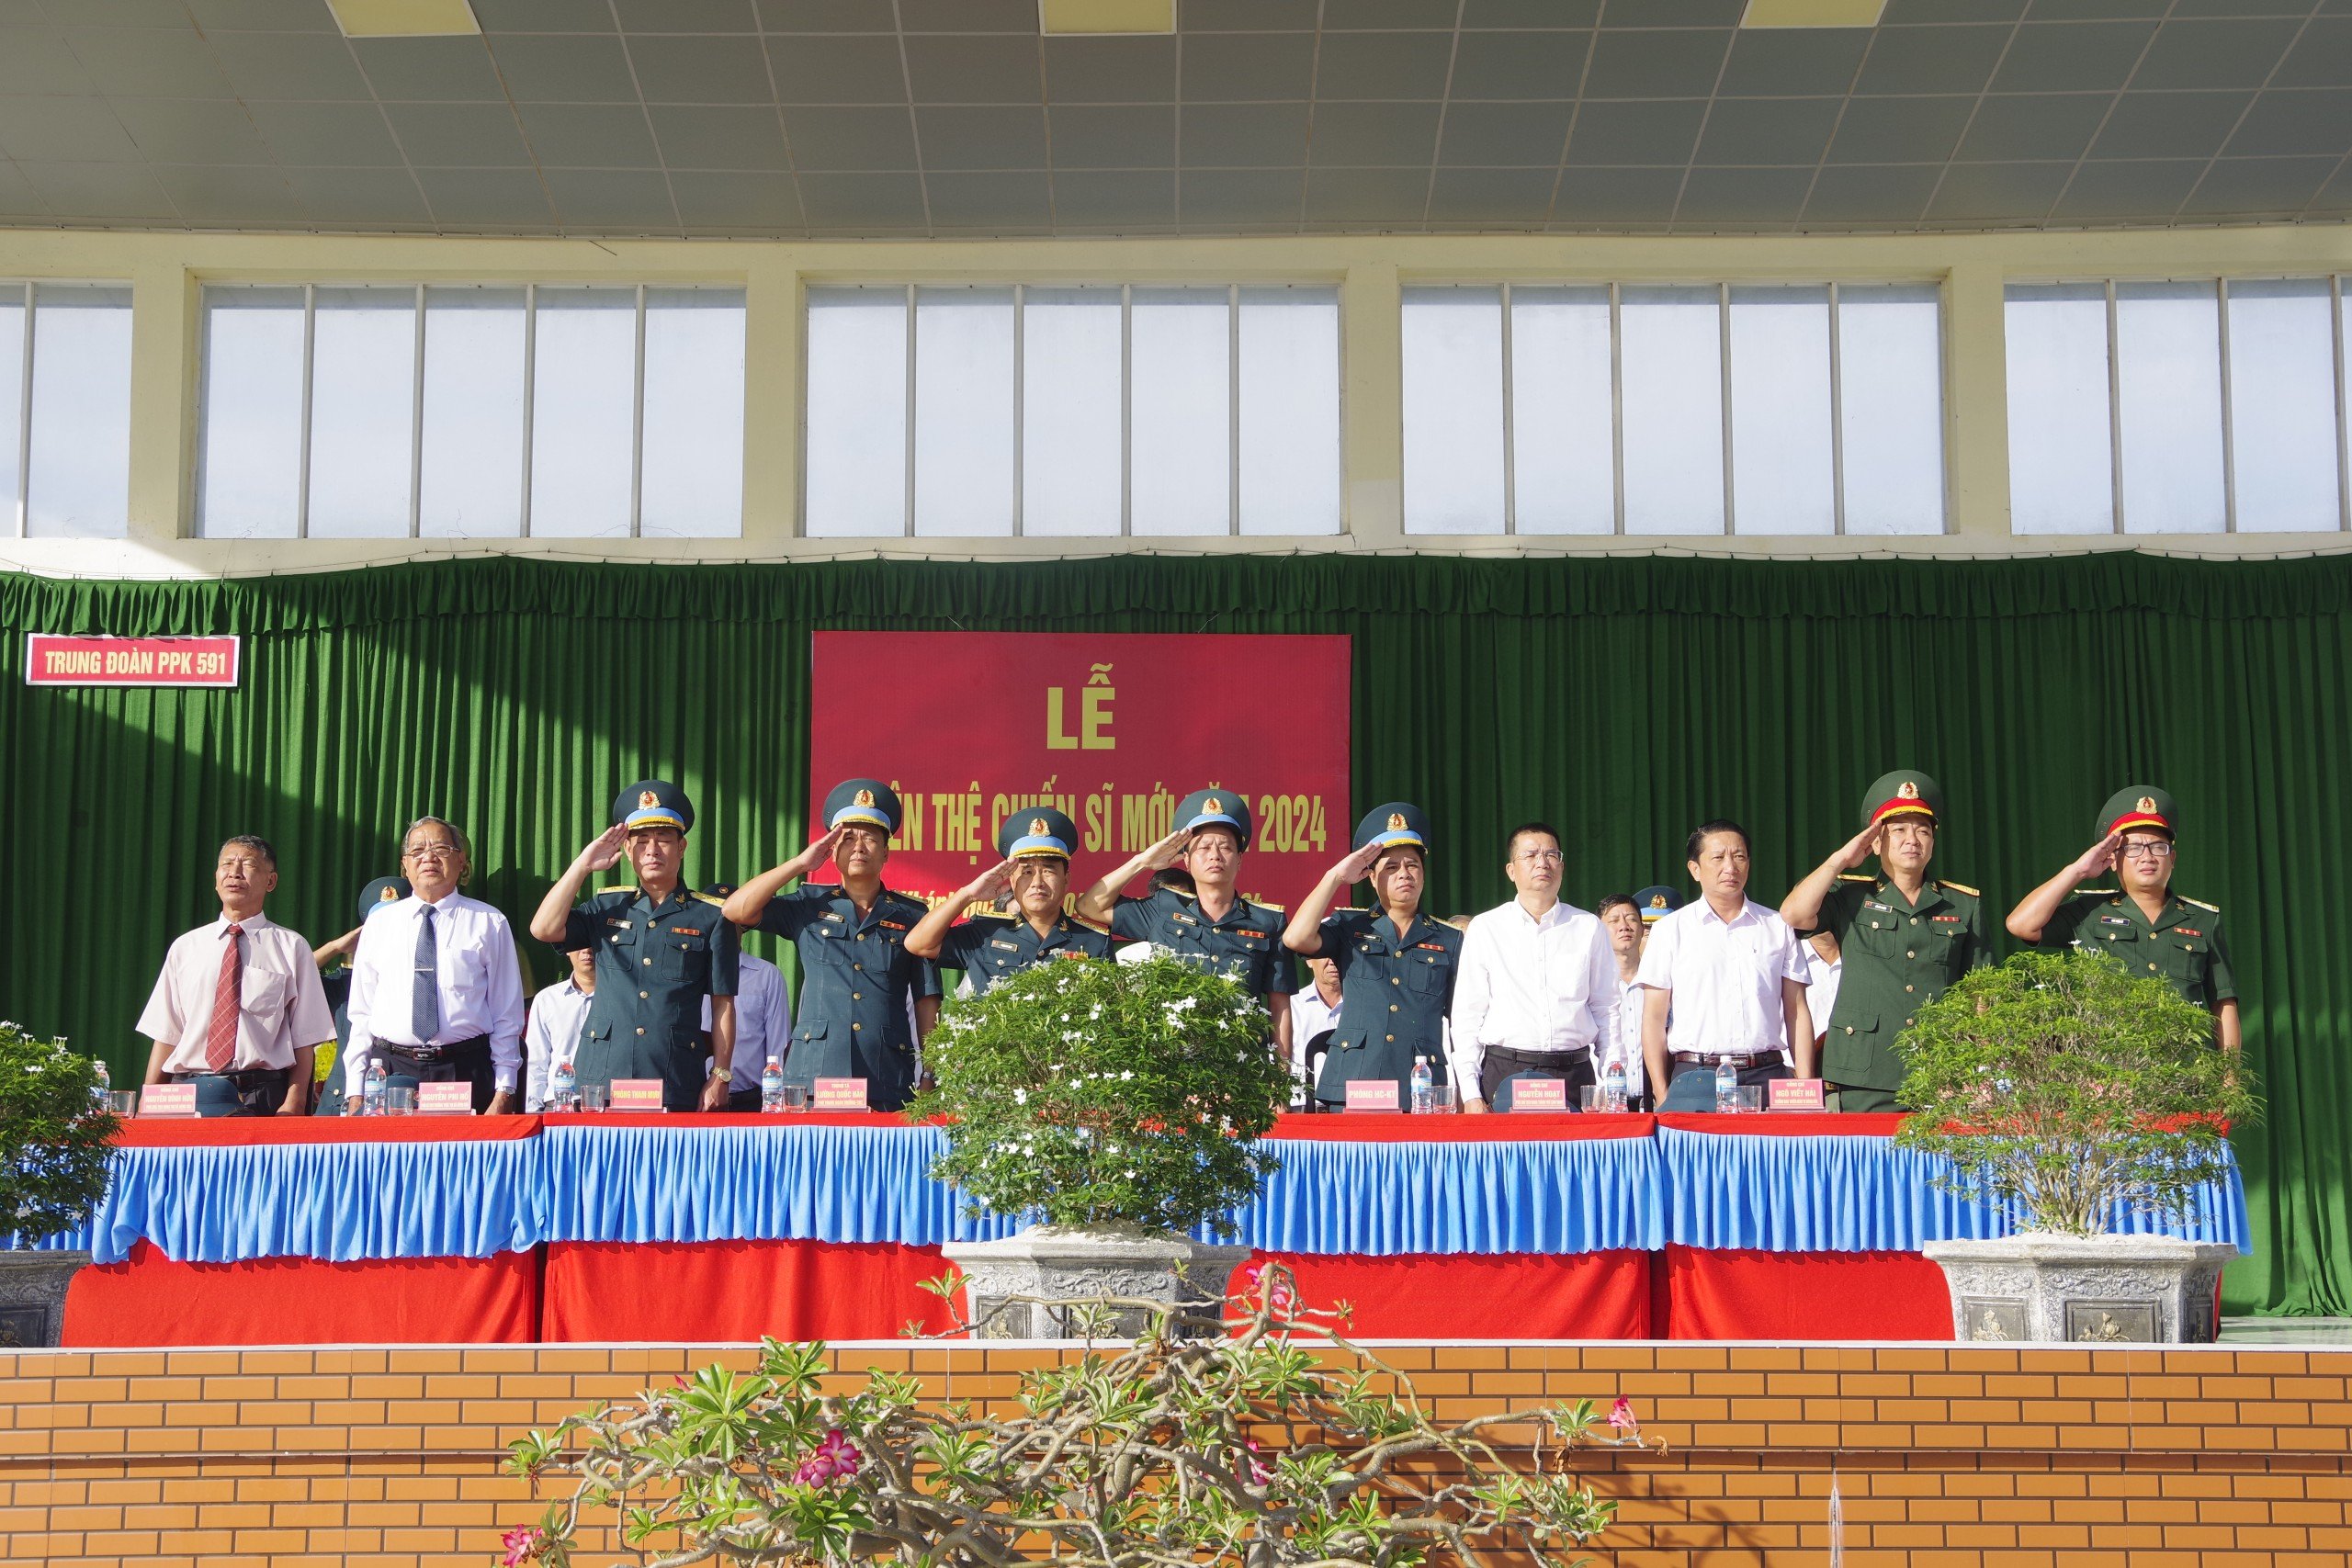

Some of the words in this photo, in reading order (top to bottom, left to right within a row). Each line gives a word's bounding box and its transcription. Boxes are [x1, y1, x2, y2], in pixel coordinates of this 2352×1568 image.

[45, 650, 102, 675] TRUNG
[106, 647, 154, 675] ĐOÀN
[158, 651, 193, 675] PPK
[197, 652, 226, 676] 591
[1046, 662, 1116, 750] LỄ
[932, 781, 982, 865] THỆ
[1084, 781, 1114, 852] SĨ
[1122, 781, 1175, 852] MỚI
[1259, 794, 1327, 853] 2024
[421, 1091, 447, 1101] NGUYỄN
[447, 1093, 458, 1101] PHI
[613, 1089, 631, 1099] PHÒNG
[631, 1090, 647, 1099] THAM
[1349, 1089, 1374, 1099] PHÒNG
[1518, 1089, 1544, 1099] NGUYỄN
[1544, 1090, 1561, 1100] HOẠT
[1790, 1088, 1804, 1098] VIẾT
